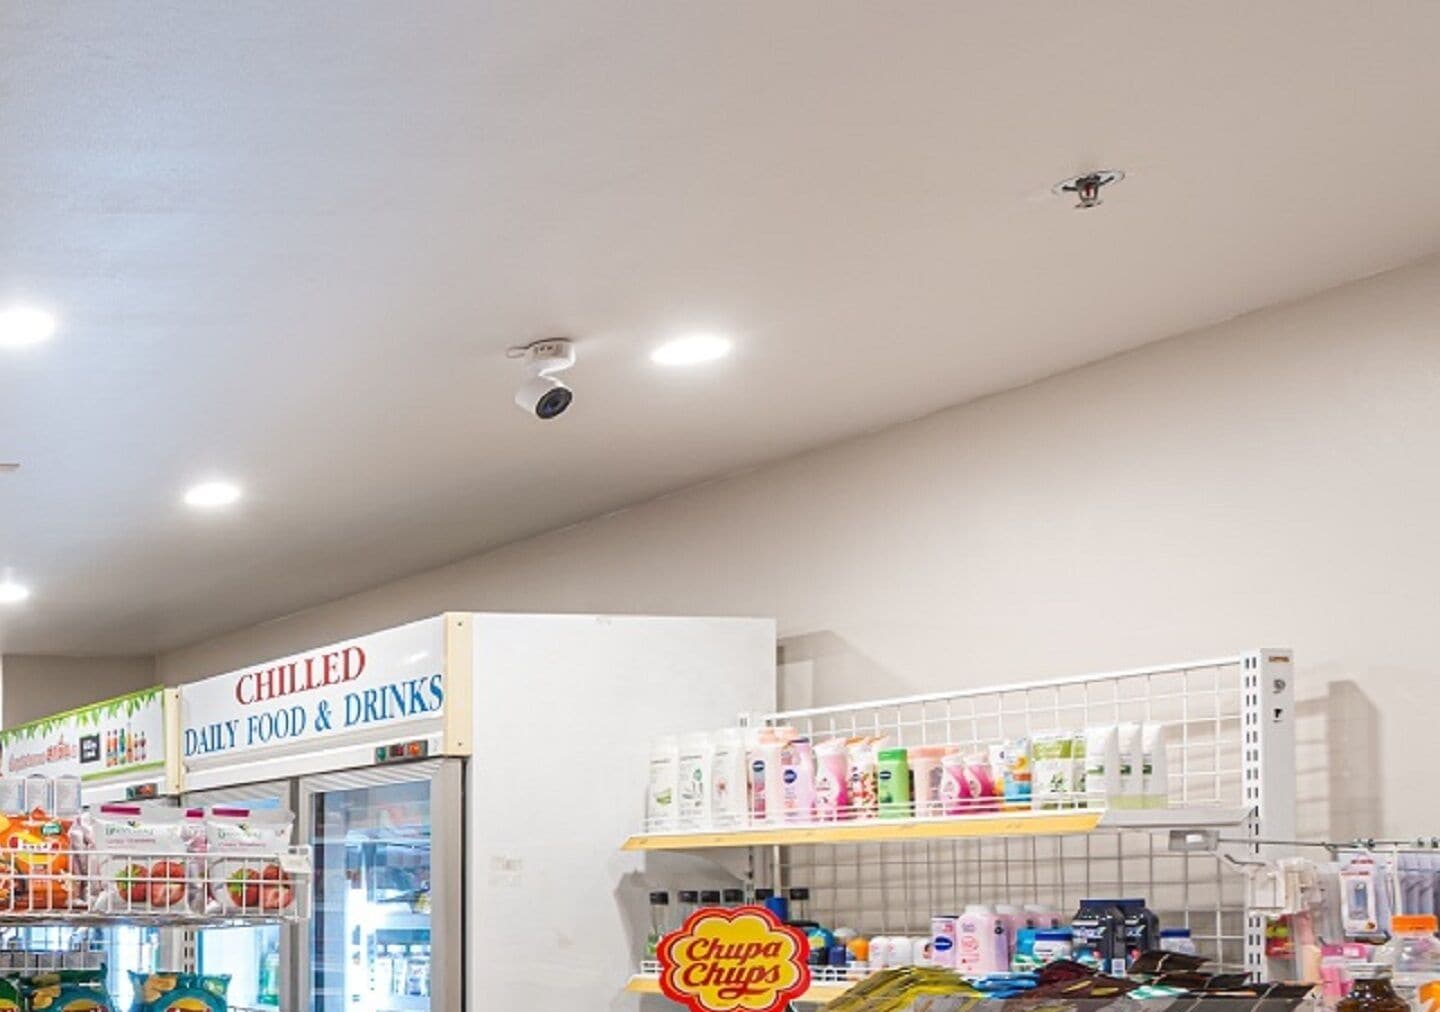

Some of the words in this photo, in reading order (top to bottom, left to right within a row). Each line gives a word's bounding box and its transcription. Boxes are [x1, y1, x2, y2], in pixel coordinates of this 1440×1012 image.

[235, 645, 366, 706] CHILLED
[183, 717, 240, 758] DAILY
[246, 704, 307, 745] FOOD
[314, 700, 332, 731] &
[343, 673, 444, 728] DRINKS
[685, 937, 784, 966] Chupa
[682, 961, 781, 1000] Chups
